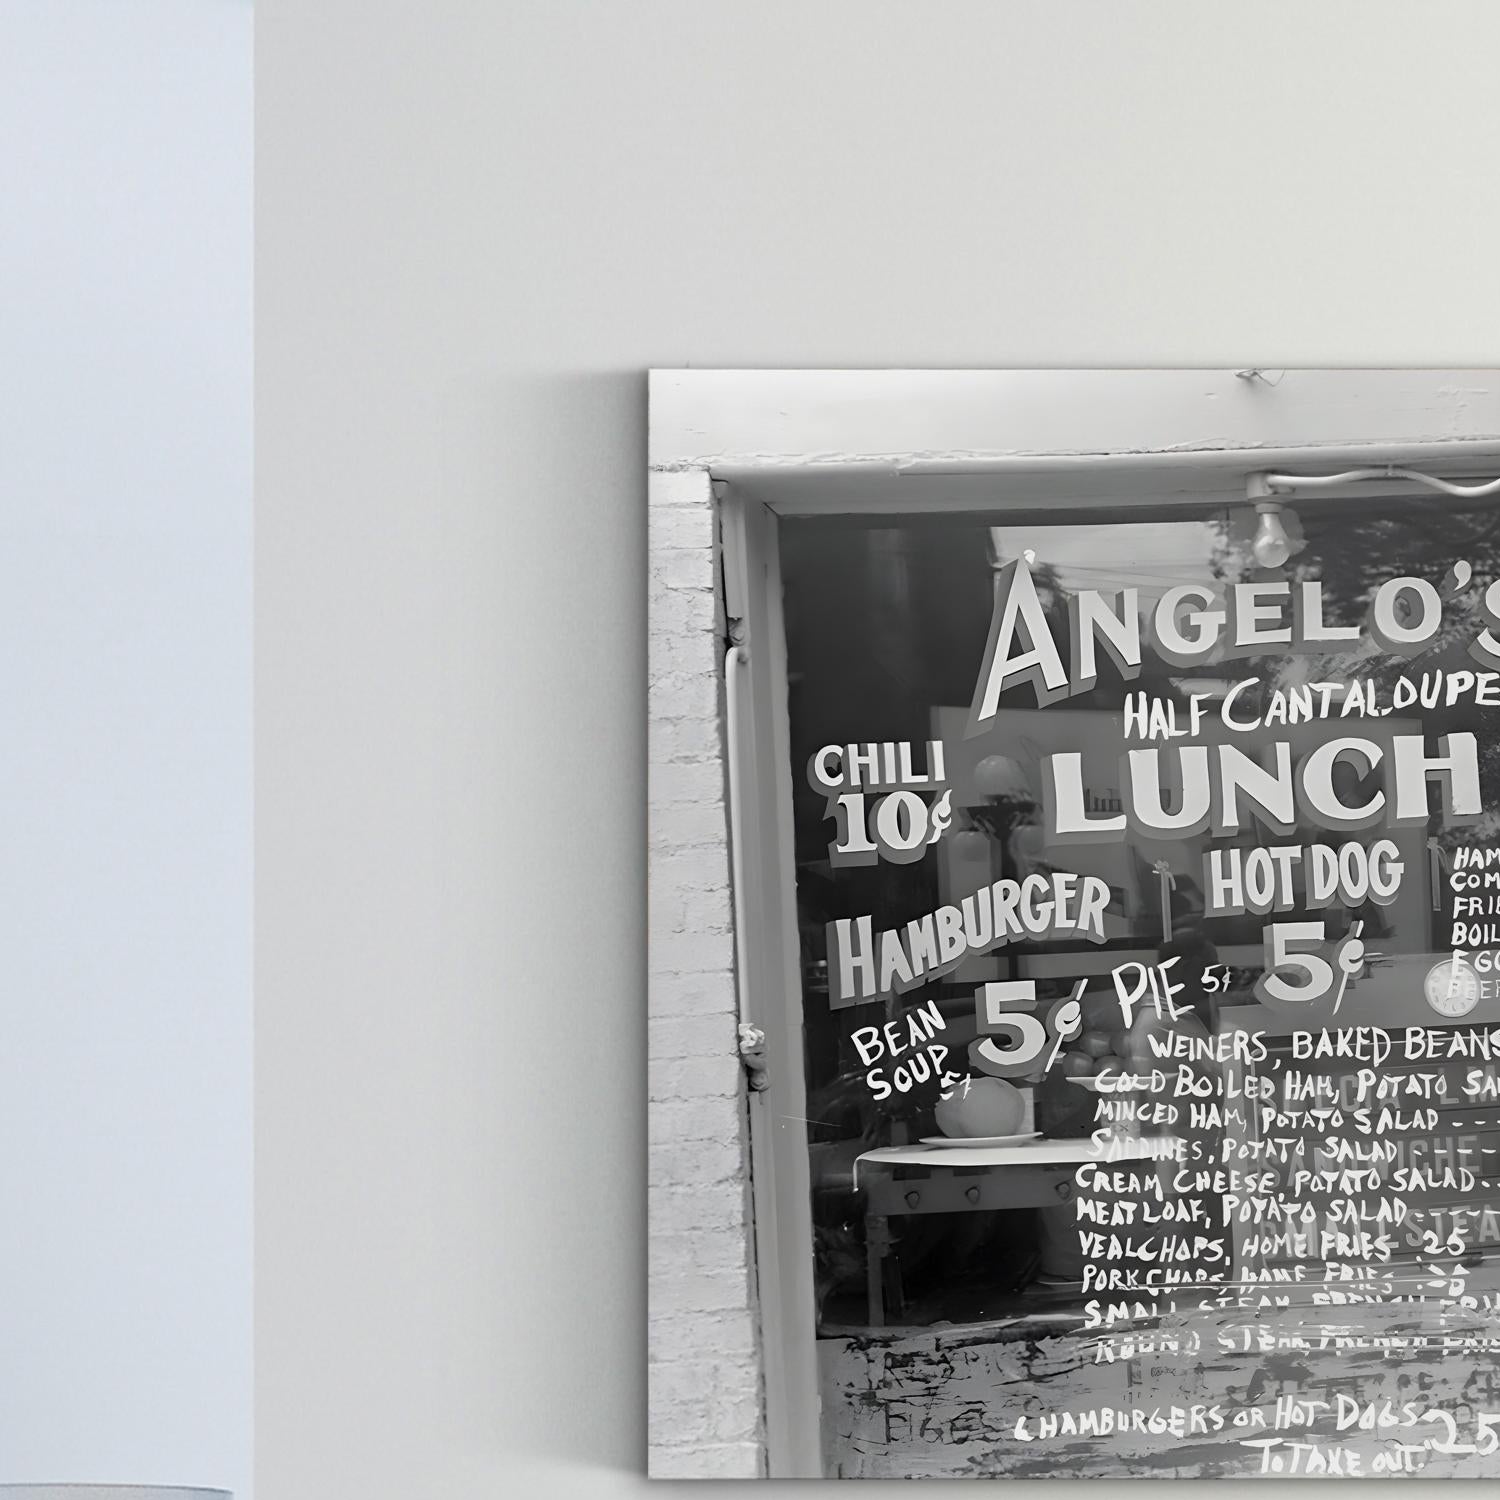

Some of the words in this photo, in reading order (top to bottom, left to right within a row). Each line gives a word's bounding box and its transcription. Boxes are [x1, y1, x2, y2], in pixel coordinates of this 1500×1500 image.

[1123, 690, 1213, 740] HALF
[1221, 668, 1500, 732] CANTALOUPE
[814, 740, 946, 787] CHILI
[1051, 732, 1483, 835] LUNCH
[836, 789, 953, 853] 10¢
[1210, 845, 1302, 909] HOT
[1311, 840, 1405, 901] DOG
[835, 872, 1112, 1000] HAMBURGER
[1112, 956, 1196, 1029] PIE
[1263, 919, 1364, 1016] 5¢
[850, 1000, 947, 1067] BEAN
[977, 978, 1089, 1074] 5¢
[1147, 1029, 1282, 1070] WEINERS,
[1292, 1027, 1391, 1067] BAKED
[866, 1044, 949, 1101] SOUP
[1173, 1064, 1275, 1099] BOILED
[1285, 1070, 1340, 1104] HAM,
[1356, 1069, 1448, 1102] POTATO
[1094, 1098, 1178, 1126] MINCED
[1261, 1106, 1344, 1134] POTATO
[1222, 1136, 1305, 1164] POTATO
[1320, 1135, 1398, 1163] SALAD
[1075, 1163, 1163, 1201] CREAM
[1295, 1168, 1381, 1198] POTATO
[1388, 1167, 1475, 1192] SALAD
[1222, 1194, 1317, 1227] POTATO
[1325, 1196, 1407, 1228] SALAD
[1241, 1232, 1308, 1259] HOME
[1320, 1230, 1393, 1263] FRIES
[1082, 1265, 1140, 1294] PORK
[1039, 1403, 1224, 1439] HAMBURGERS
[1274, 1394, 1331, 1430] HOT
